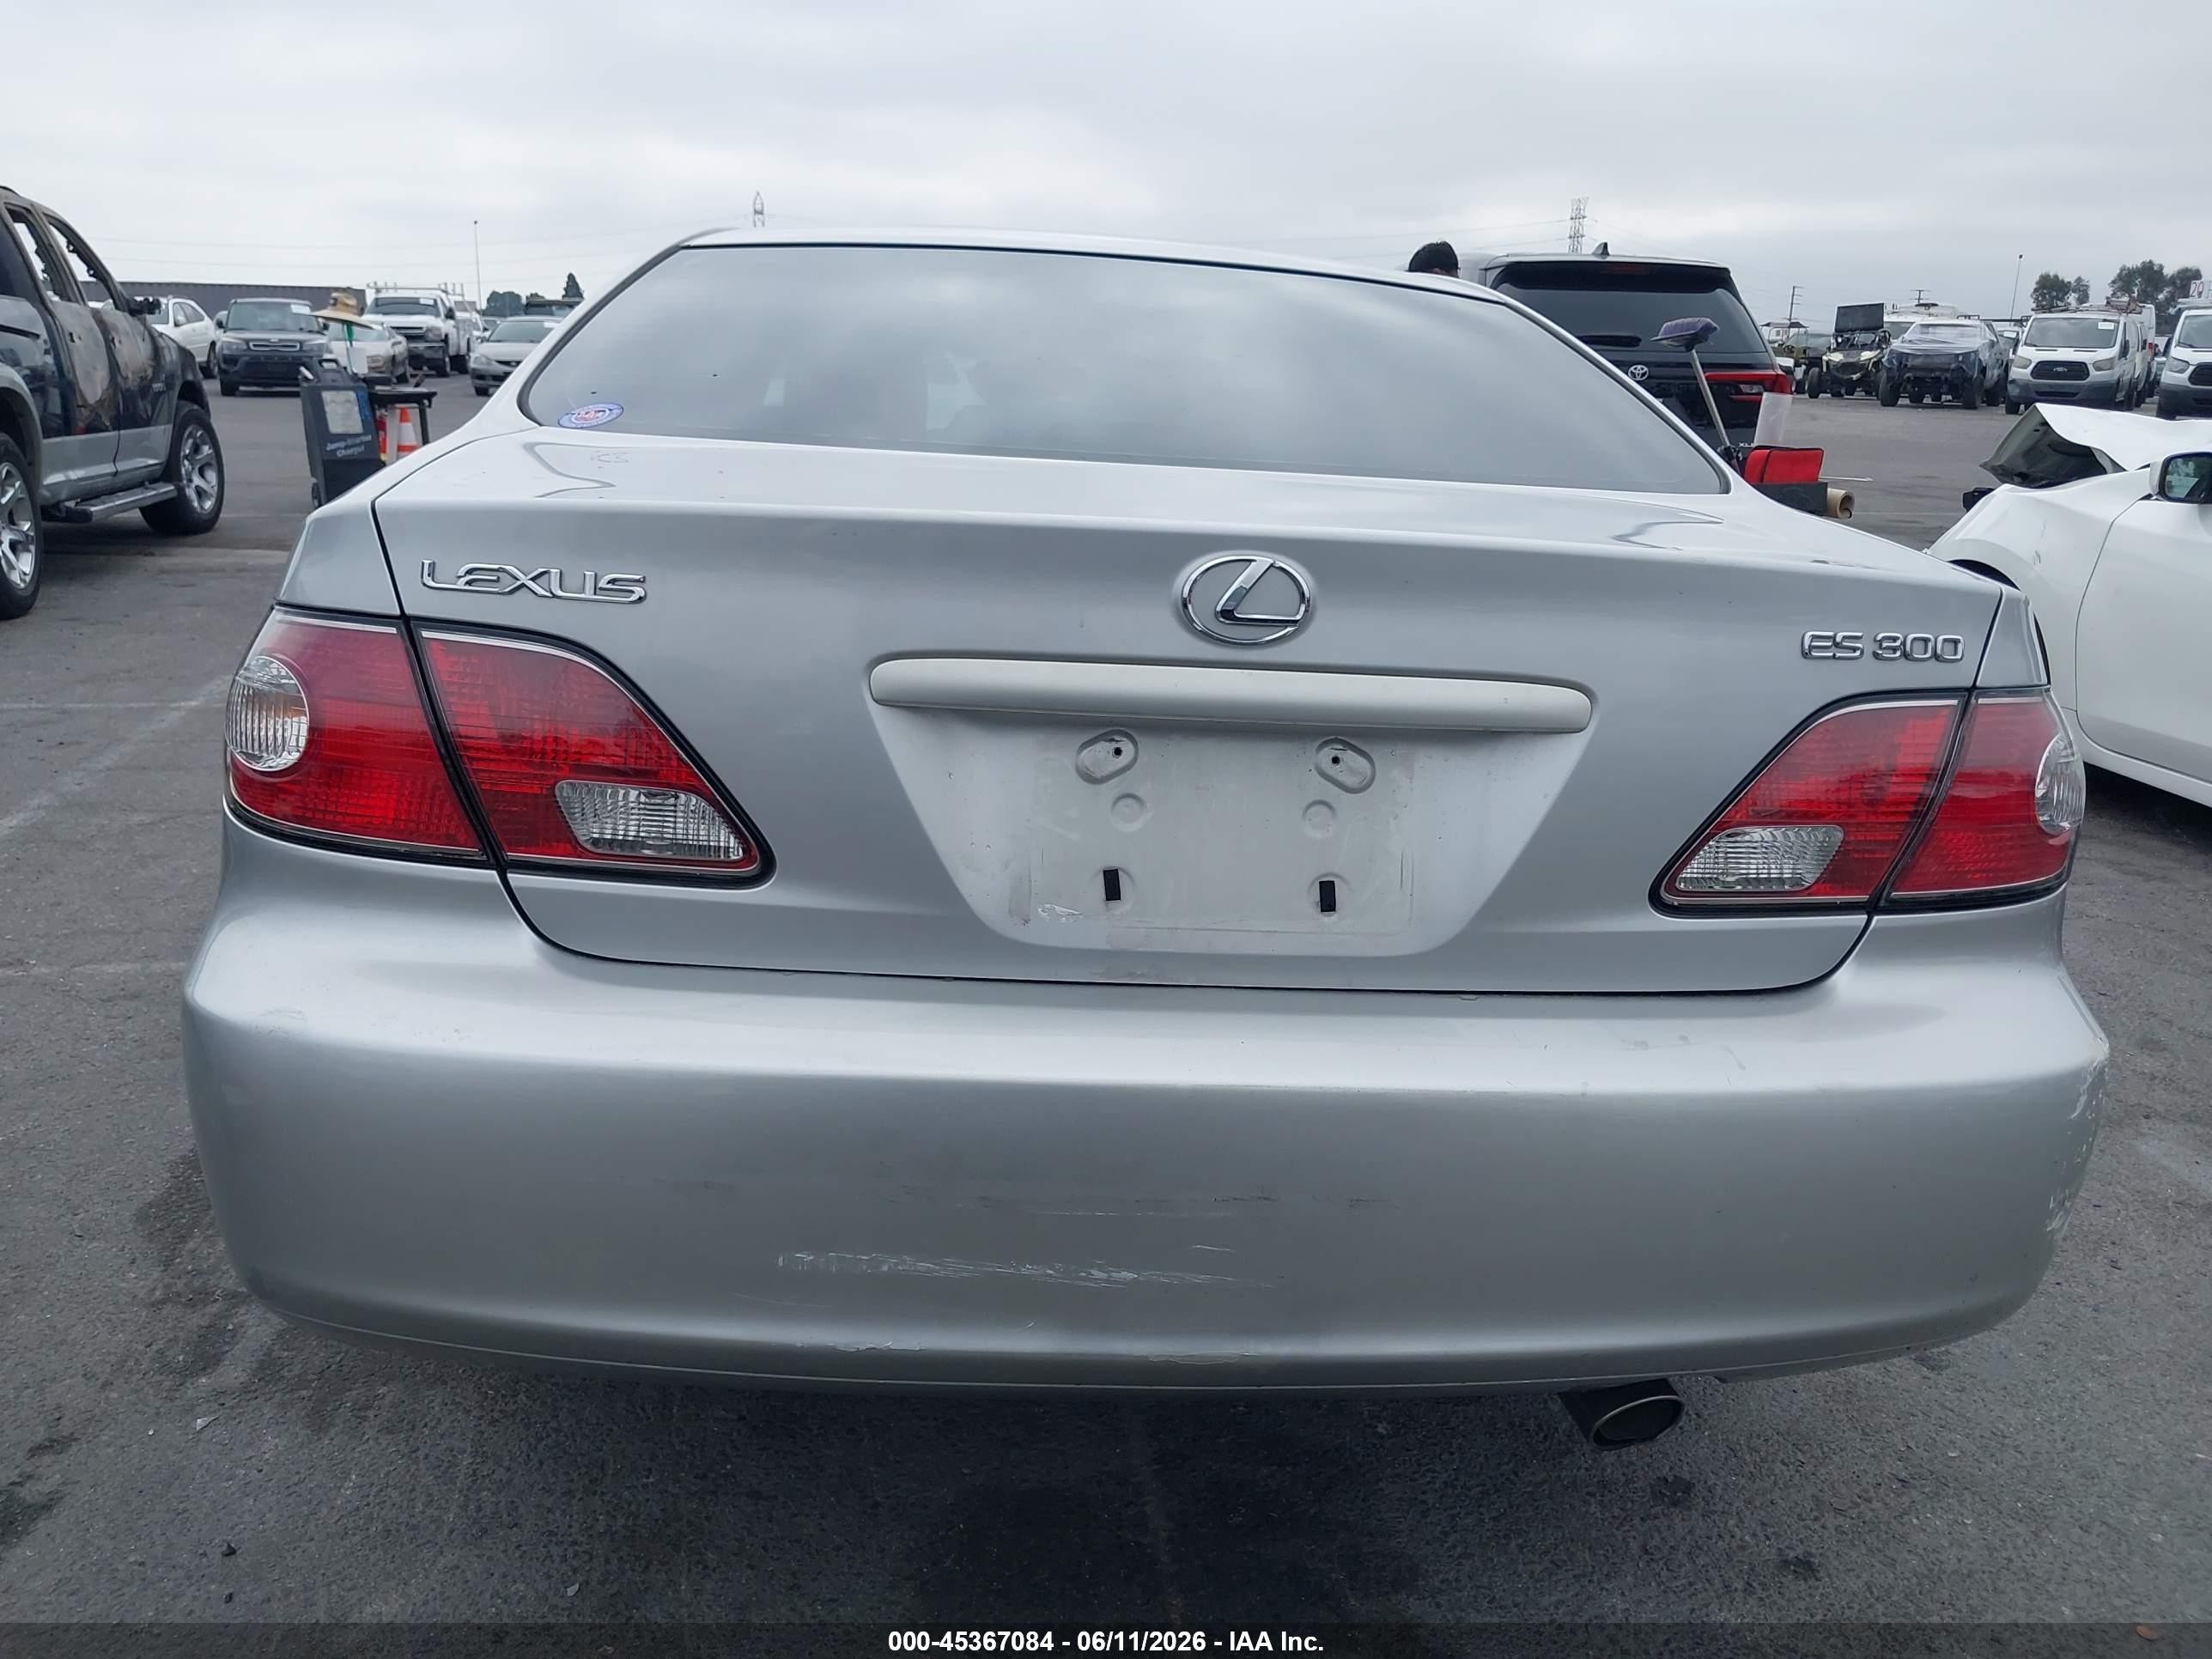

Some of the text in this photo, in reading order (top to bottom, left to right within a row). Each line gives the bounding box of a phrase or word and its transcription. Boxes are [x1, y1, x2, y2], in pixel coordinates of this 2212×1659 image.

[421, 559, 647, 604] LEXUS
[1802, 631, 1965, 663] ES 300
